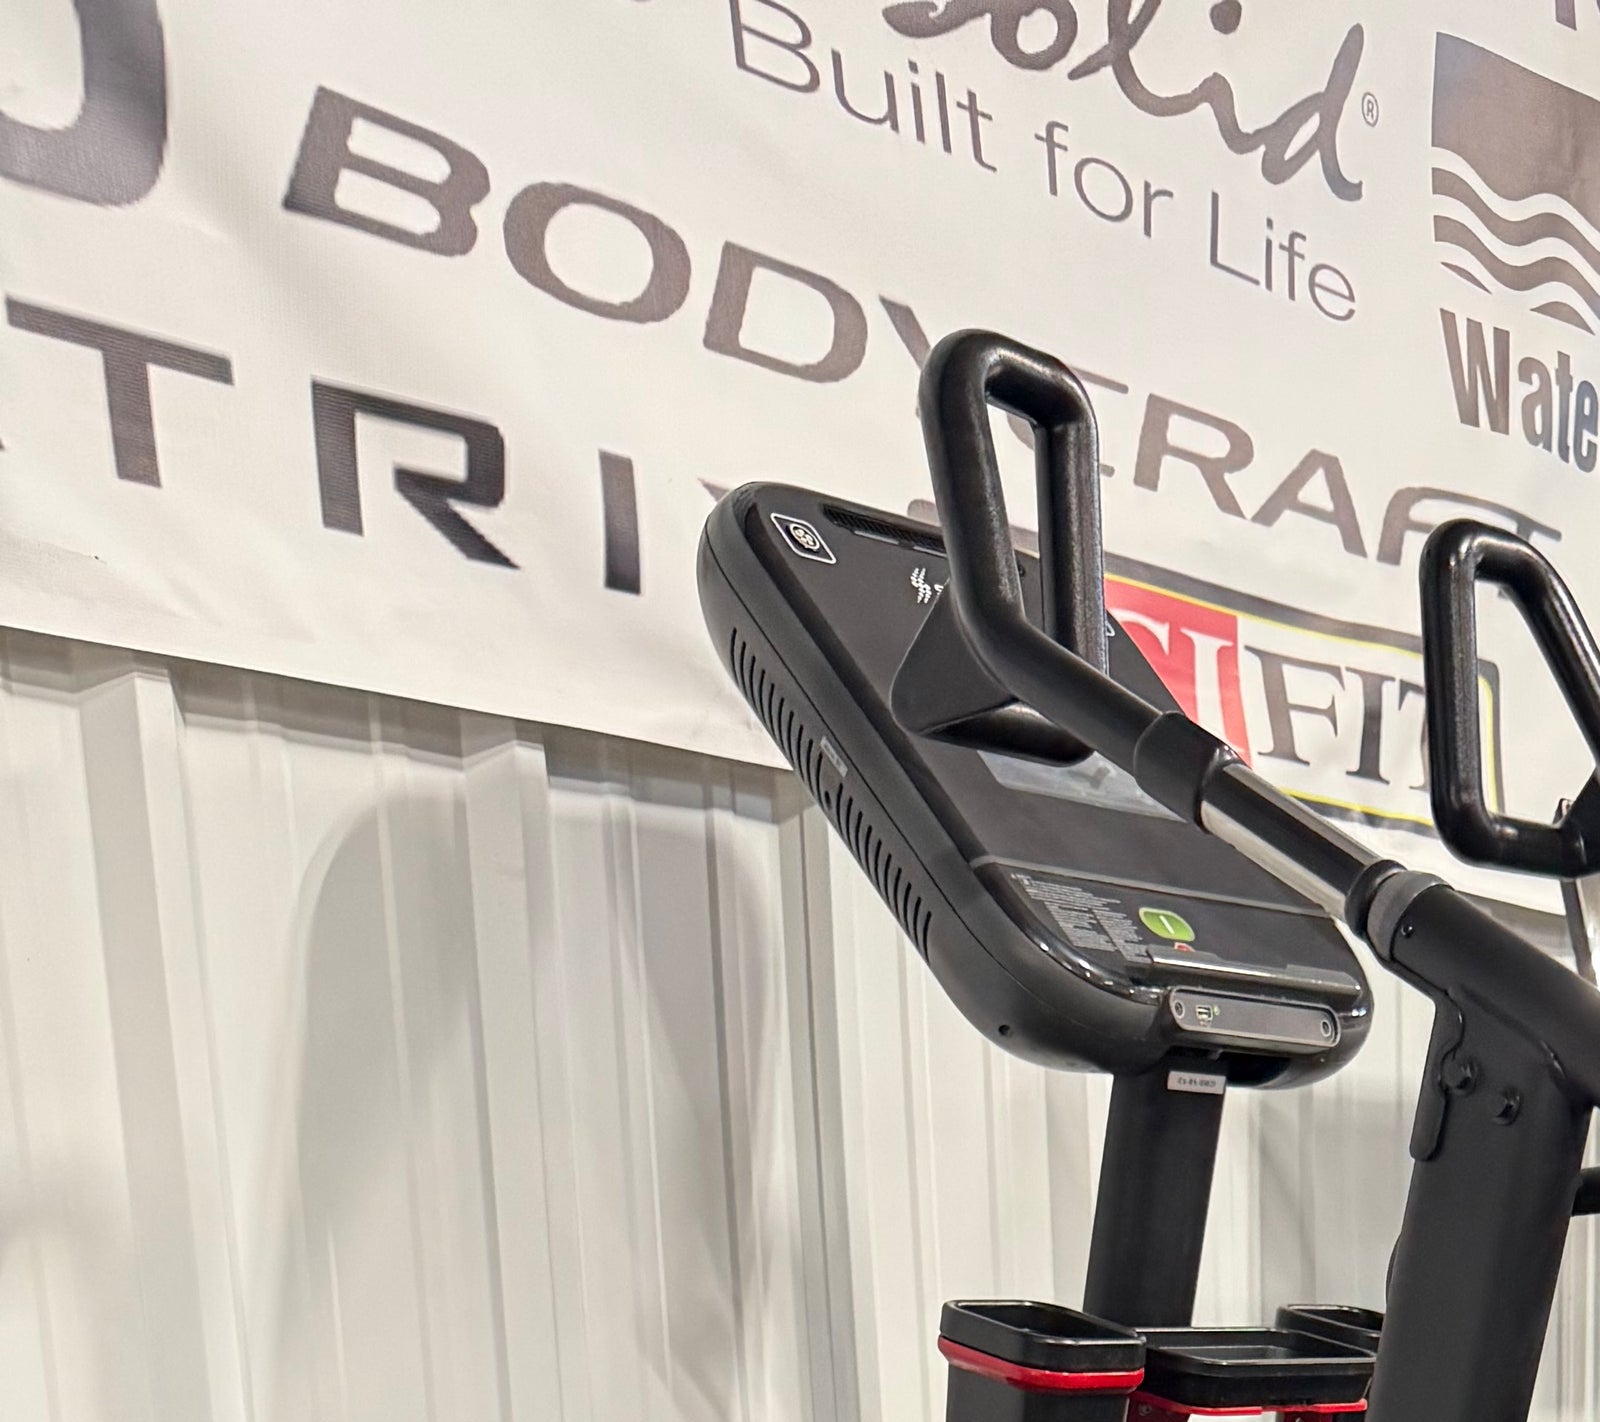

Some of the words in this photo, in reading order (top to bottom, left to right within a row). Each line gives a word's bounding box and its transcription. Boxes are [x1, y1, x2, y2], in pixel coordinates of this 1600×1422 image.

[729, 0, 998, 173] Built
[1035, 121, 1174, 238] for
[1208, 191, 1357, 321] Life
